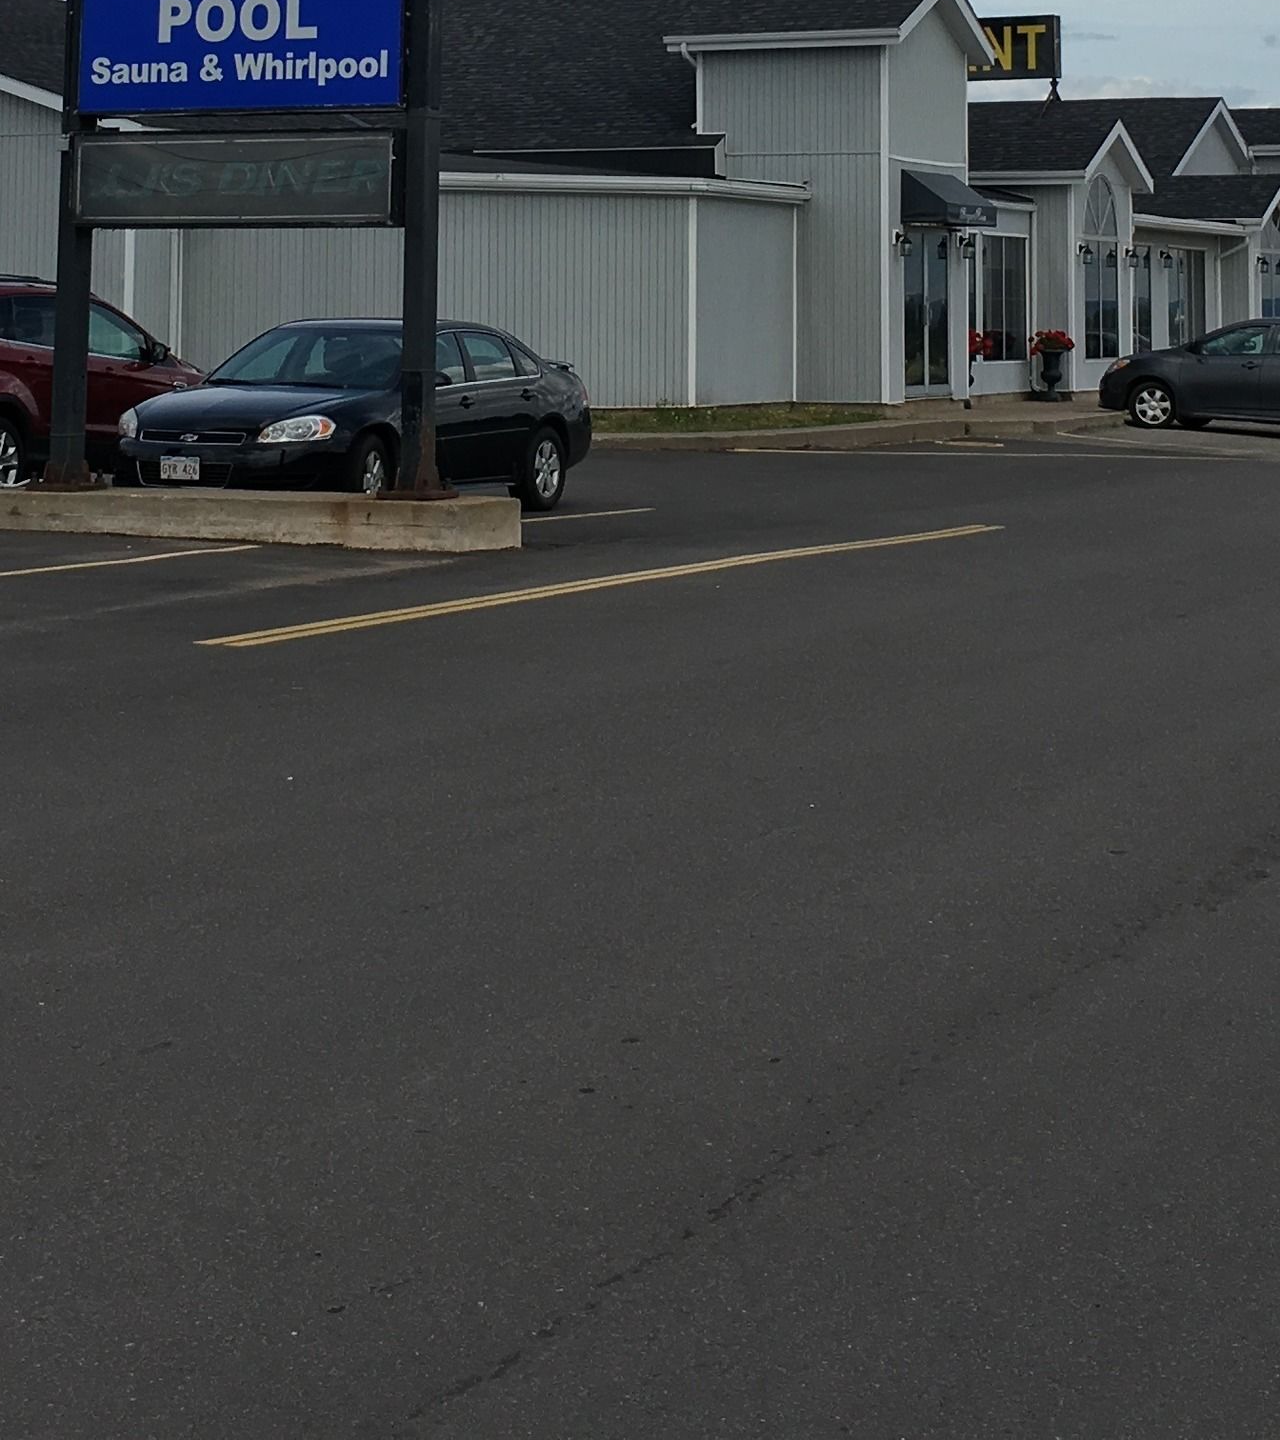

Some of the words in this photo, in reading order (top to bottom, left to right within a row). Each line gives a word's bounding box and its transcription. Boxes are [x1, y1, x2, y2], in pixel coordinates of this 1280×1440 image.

[91, 57, 188, 85] Sauna
[199, 53, 224, 82] &
[234, 49, 389, 86] Whirlpool
[969, 24, 1046, 71] NT
